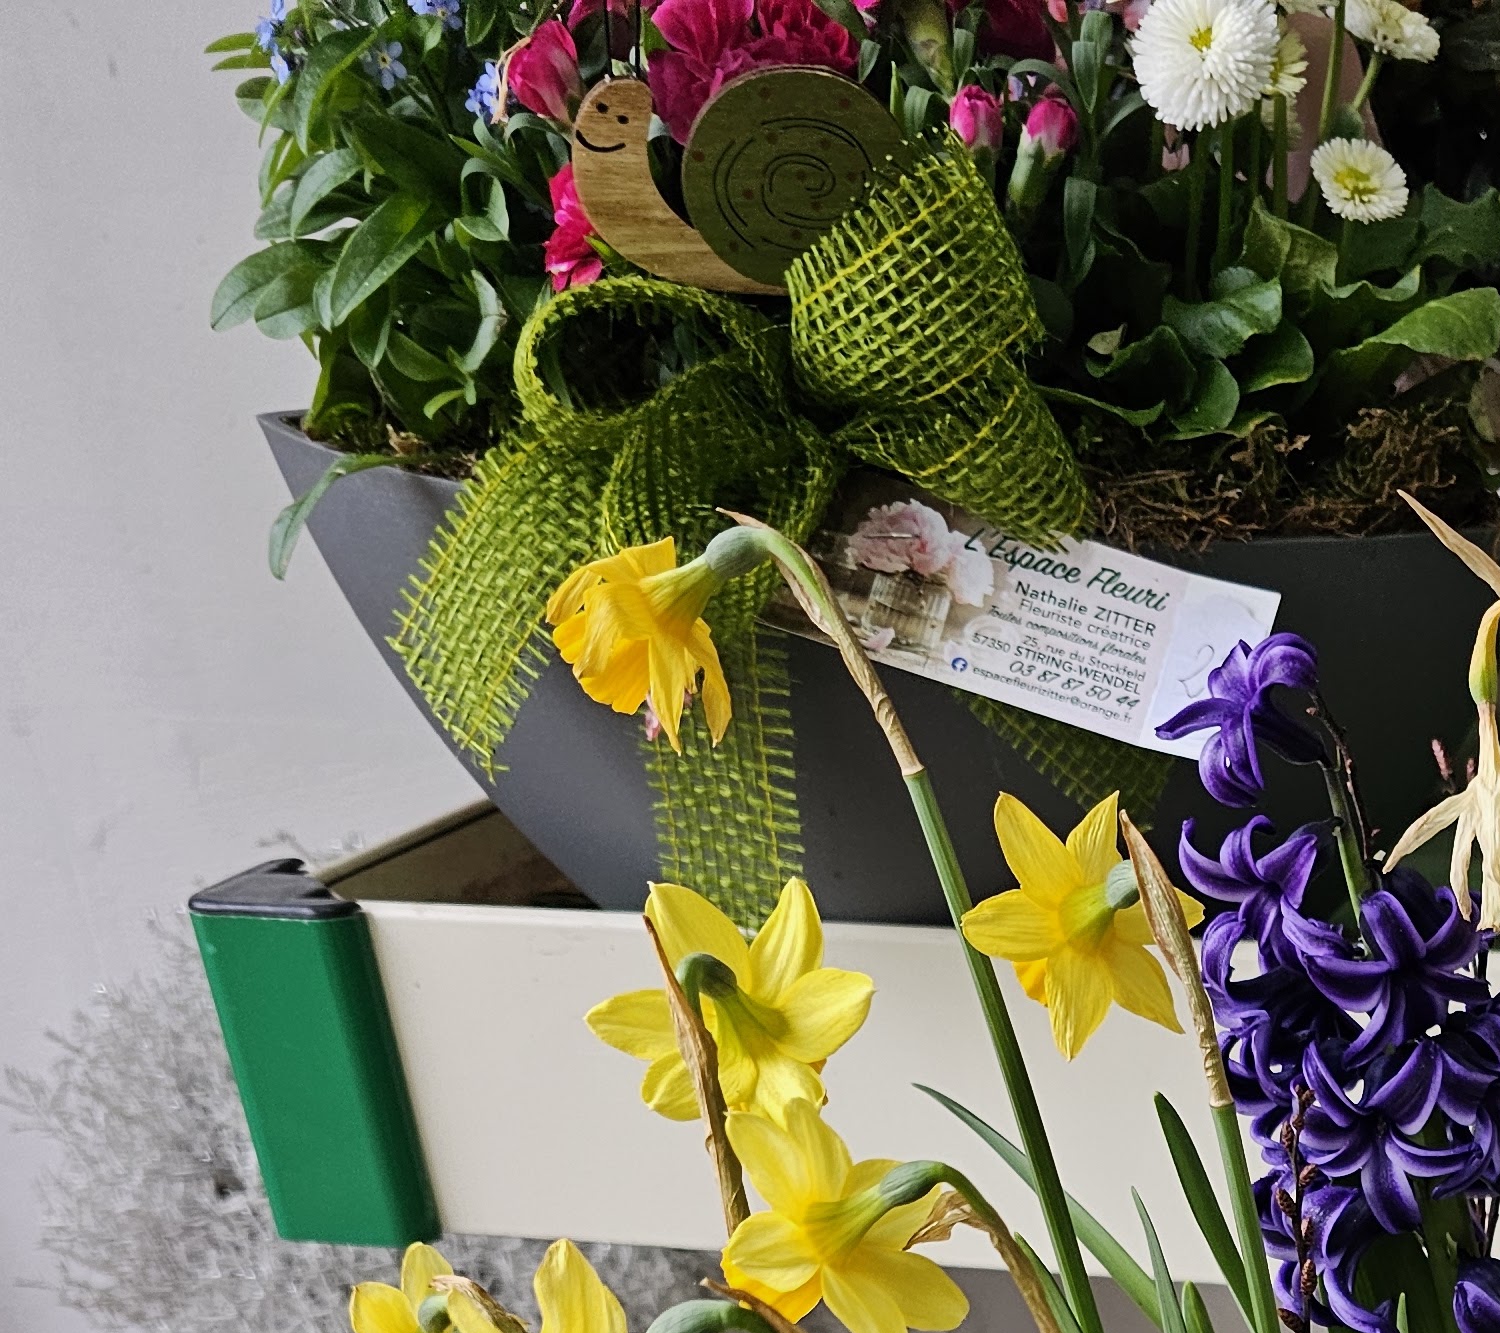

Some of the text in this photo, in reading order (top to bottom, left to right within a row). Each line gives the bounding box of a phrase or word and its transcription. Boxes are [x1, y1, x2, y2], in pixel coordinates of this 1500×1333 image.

[964, 527, 1171, 613] L'Espace Fleuri
[987, 604, 1147, 666] Toutes compositions florales
[1014, 580, 1157, 638] Nathalie ZITTER
[1019, 598, 1152, 651] Fleuriste créatrice
[971, 632, 1142, 696] 57350 STIRING-WENDEL
[1009, 660, 1142, 711] 03 87 87 50 44
[1046, 645, 1066, 658] rue
[1069, 650, 1085, 664] du
[1089, 656, 1146, 683] Stockfeld
[972, 666, 1133, 724] espacefleurizitter@orange.fr
